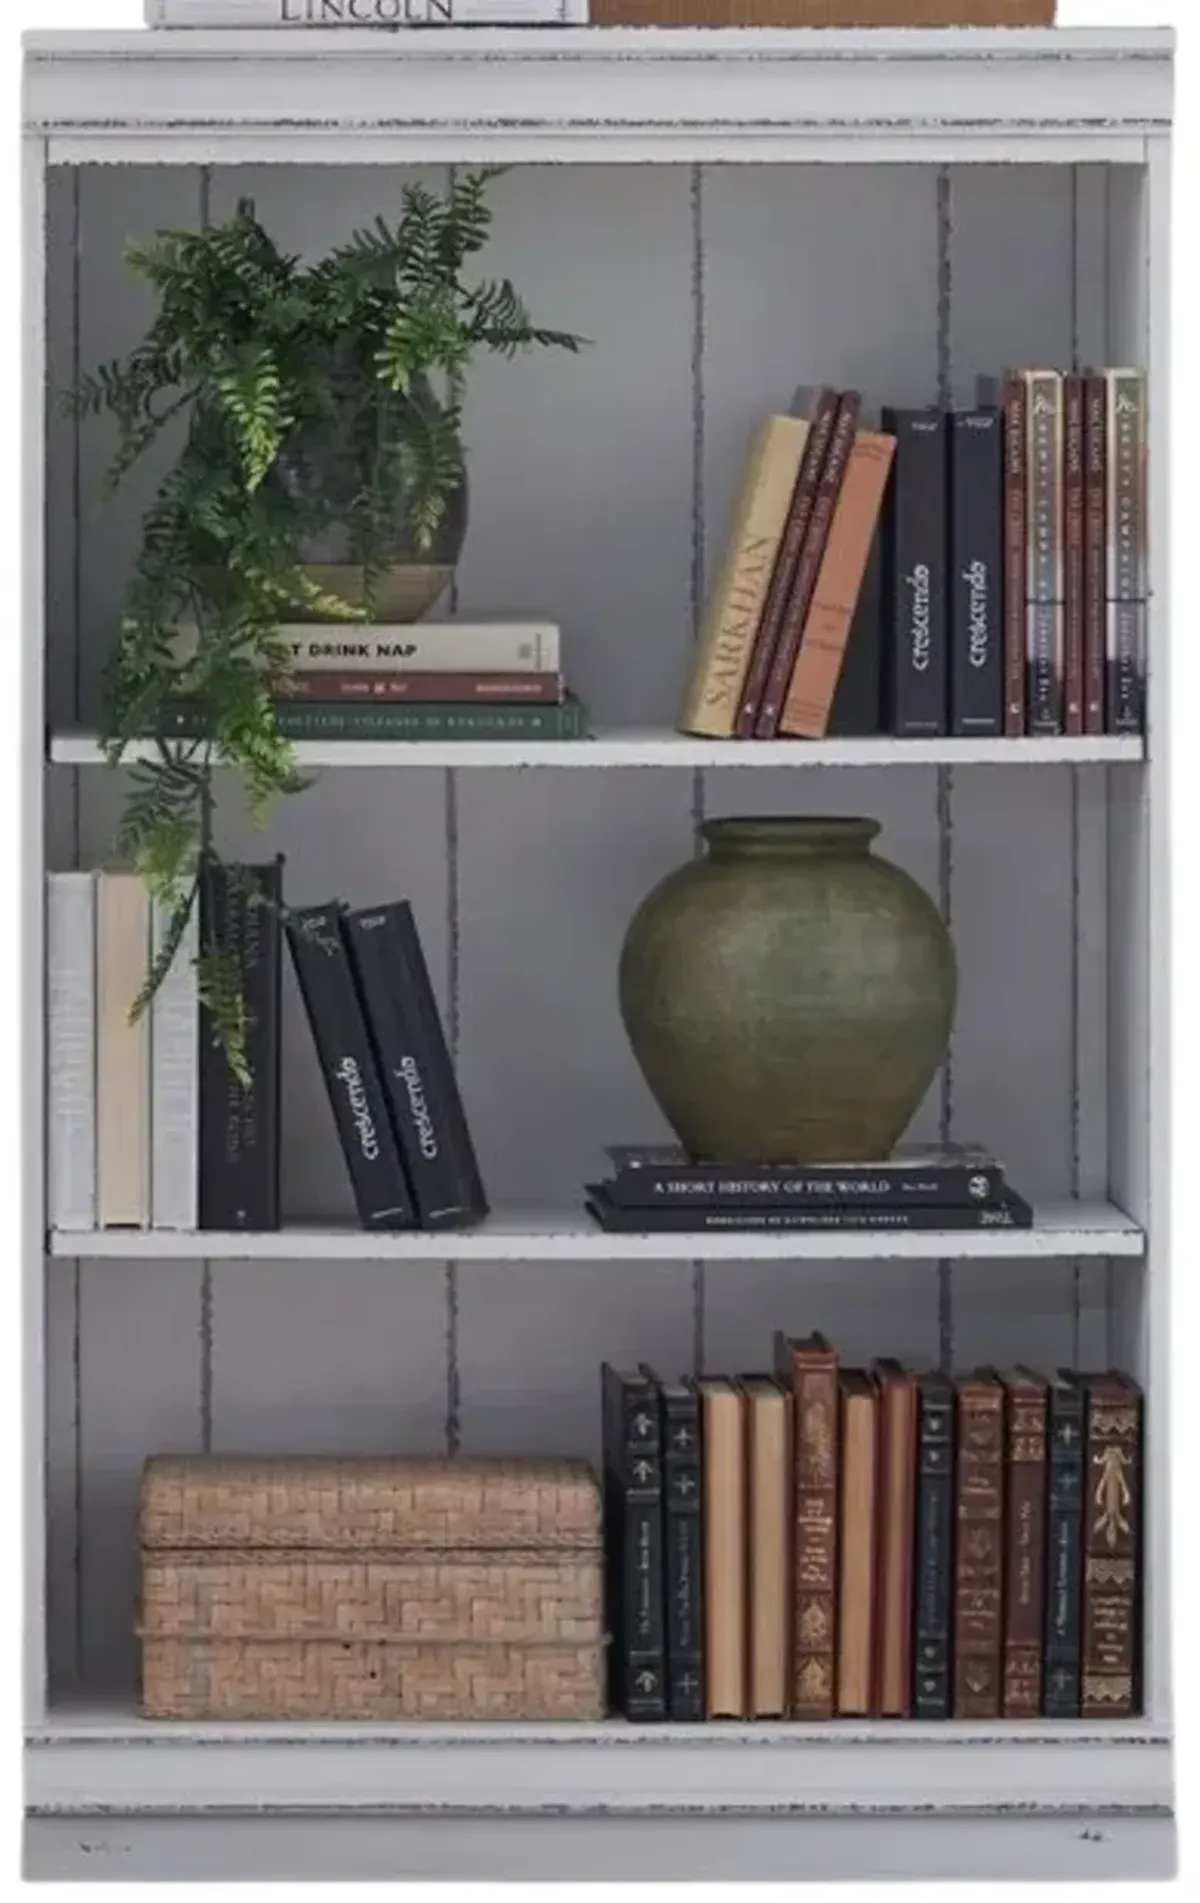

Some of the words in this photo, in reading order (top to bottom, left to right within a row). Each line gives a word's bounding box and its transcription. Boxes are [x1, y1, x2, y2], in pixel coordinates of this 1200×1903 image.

[281, 0, 453, 21] LINCOLN
[308, 643, 370, 658] DRINK
[376, 643, 418, 658] NAP
[906, 564, 930, 671] crescendo
[962, 561, 988, 668] crescendo
[336, 1056, 380, 1160] crescendo
[393, 1056, 438, 1159] crescendo
[653, 1181, 665, 1194] A
[667, 1181, 715, 1194] SHORT
[719, 1181, 780, 1194] HISTORY
[783, 1181, 803, 1194] OF
[806, 1181, 833, 1194] THE
[836, 1181, 891, 1194] WORLD
